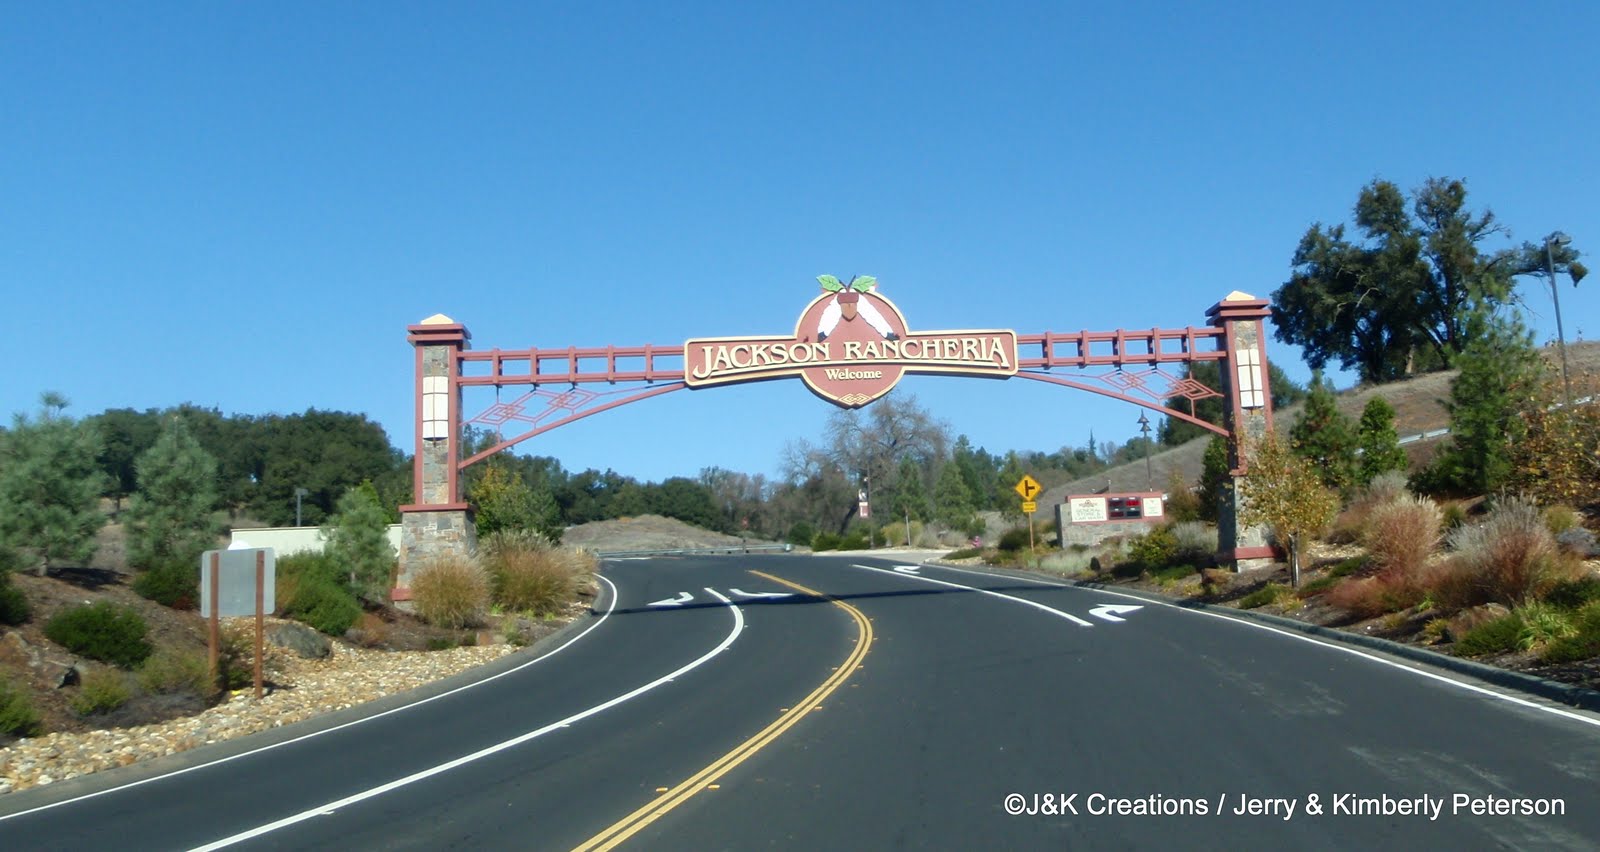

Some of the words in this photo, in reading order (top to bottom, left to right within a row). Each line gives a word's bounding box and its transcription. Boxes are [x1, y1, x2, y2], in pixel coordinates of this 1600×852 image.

[692, 342, 831, 379] JACKSON
[843, 337, 1011, 368] RANCHERIA
[825, 368, 882, 380] Welcome
